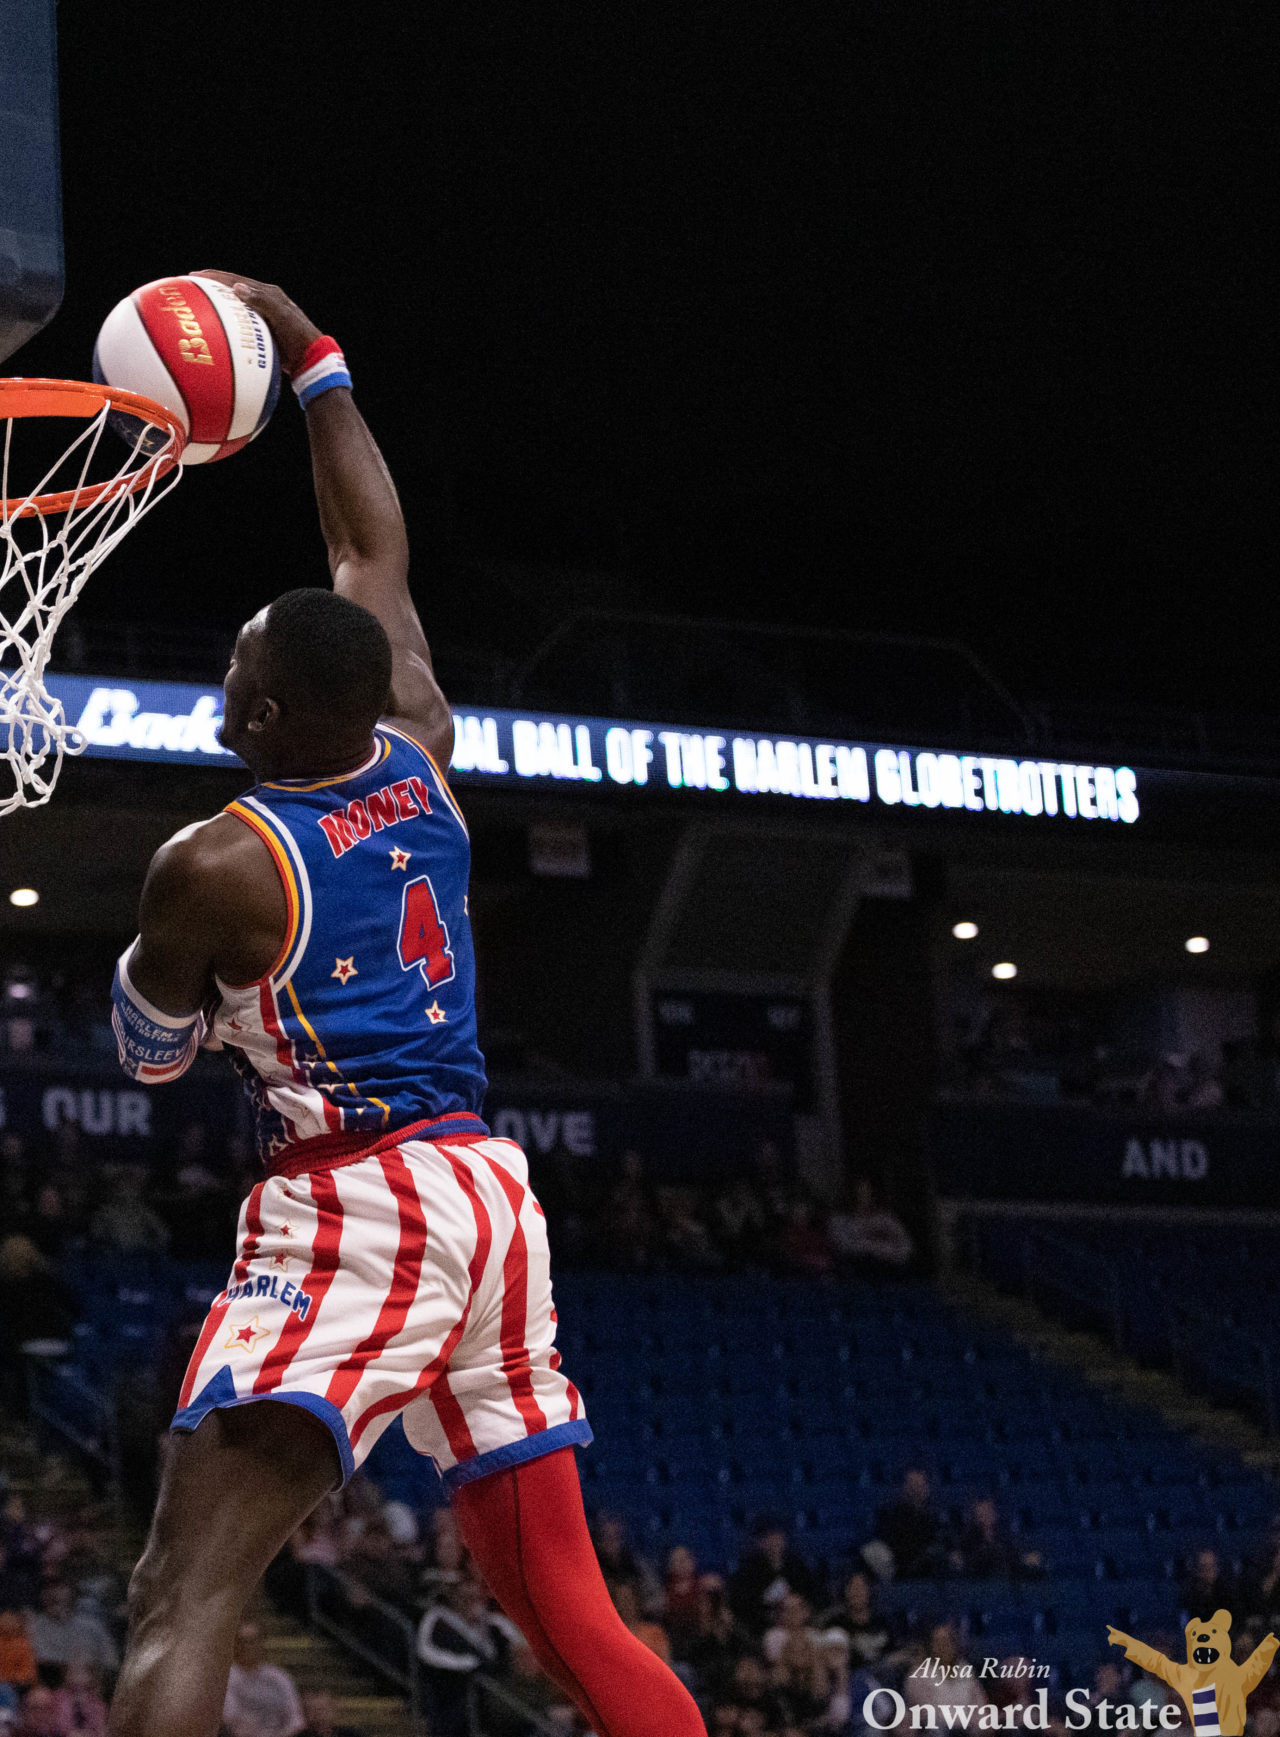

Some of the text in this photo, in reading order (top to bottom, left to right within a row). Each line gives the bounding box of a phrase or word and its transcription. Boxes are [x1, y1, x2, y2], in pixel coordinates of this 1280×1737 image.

[158, 286, 215, 367] Baden
[512, 719, 603, 781] BALL
[605, 727, 655, 786] OF
[659, 732, 730, 791] THE
[732, 738, 871, 802] HARLEM
[874, 749, 1140, 824] GLOBETROTTERS
[318, 775, 433, 859] MONEY
[397, 874, 456, 992] 4
[493, 1107, 596, 1158] OVE
[1122, 1138, 1210, 1181] AND
[217, 1274, 312, 1321] HARLEM
